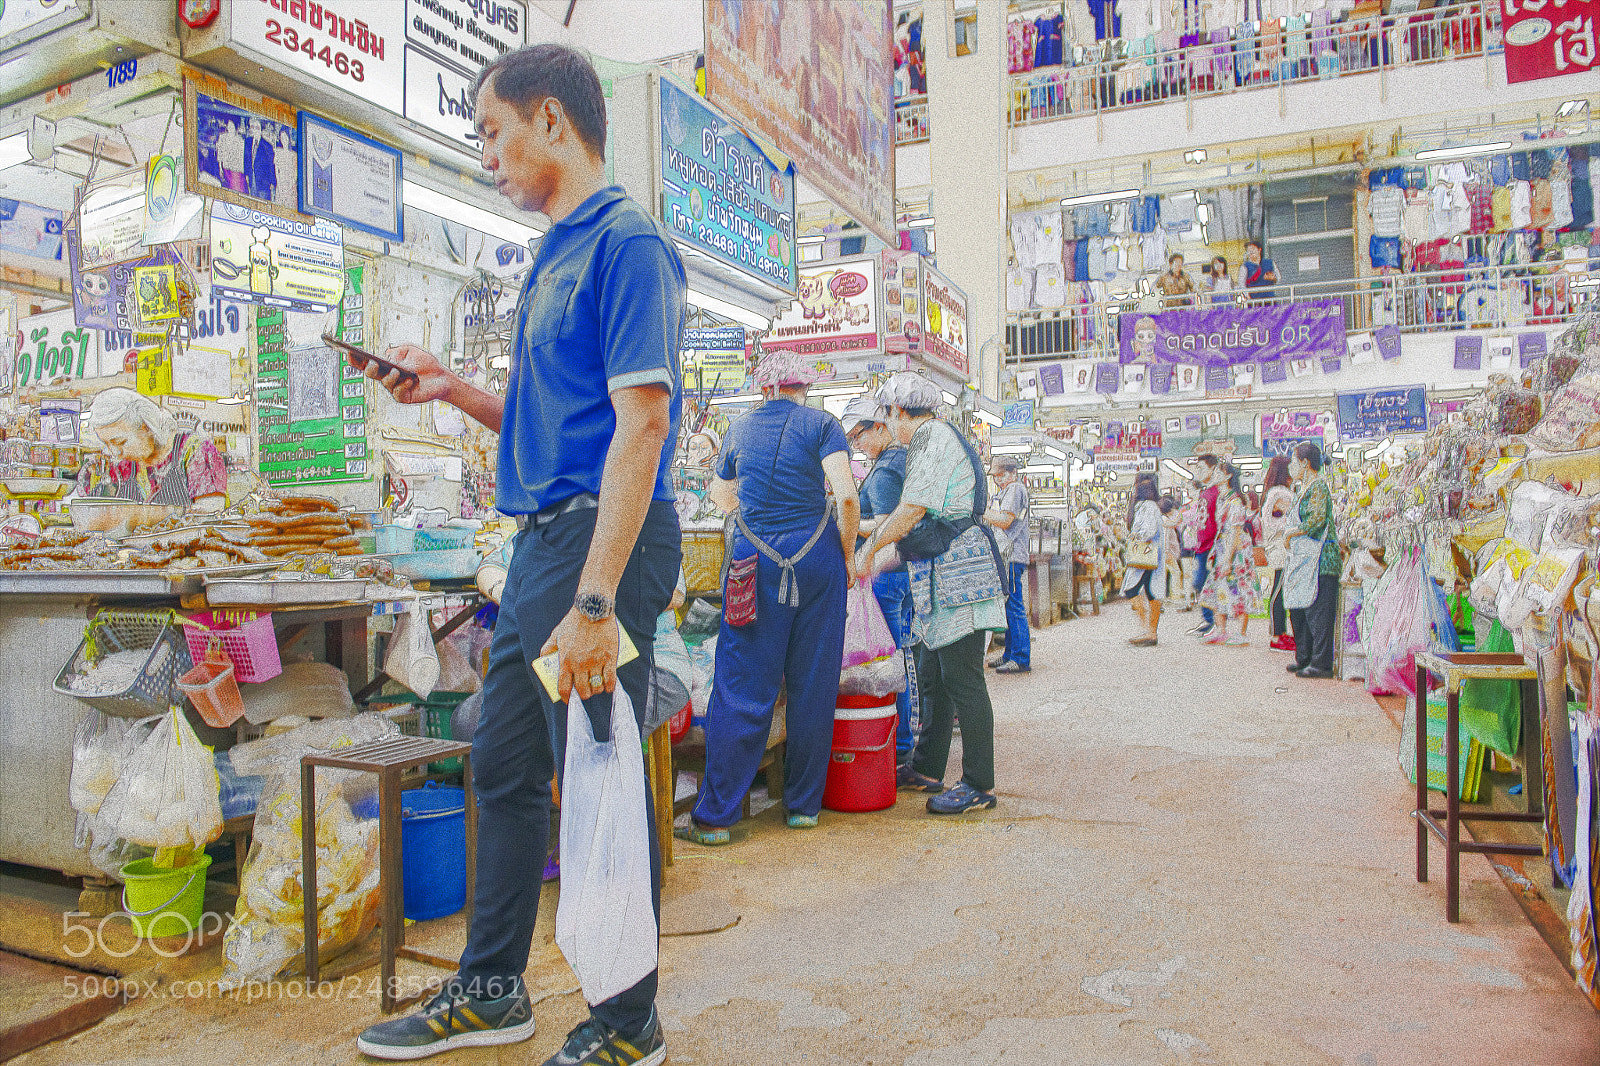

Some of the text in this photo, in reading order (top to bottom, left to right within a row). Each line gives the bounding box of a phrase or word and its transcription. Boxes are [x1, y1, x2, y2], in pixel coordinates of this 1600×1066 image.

[264, 18, 365, 83] 234463
[105, 59, 138, 88] 1/89
[252, 210, 294, 233] Cooking
[294, 220, 309, 235] Oil
[1165, 322, 1312, 350] ตลาดนี้รับ QR
[202, 420, 247, 433] CROWN
